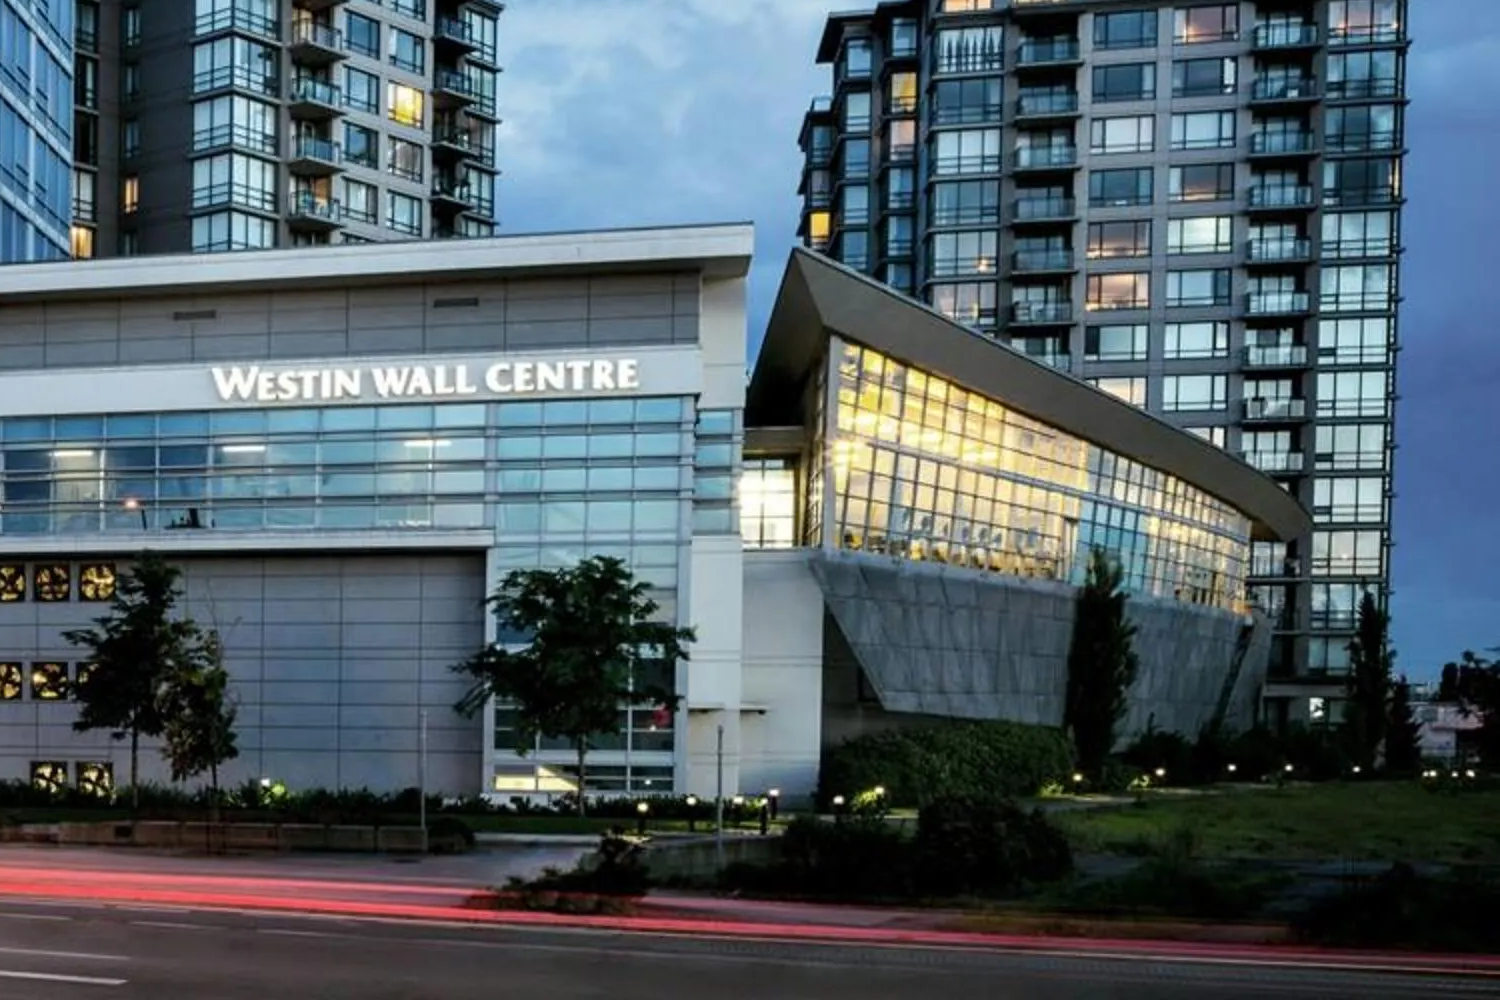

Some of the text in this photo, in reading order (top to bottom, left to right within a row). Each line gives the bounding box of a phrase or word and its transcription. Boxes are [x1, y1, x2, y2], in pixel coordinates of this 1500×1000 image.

[211, 358, 641, 400] WESTIN WALL CENTRE
